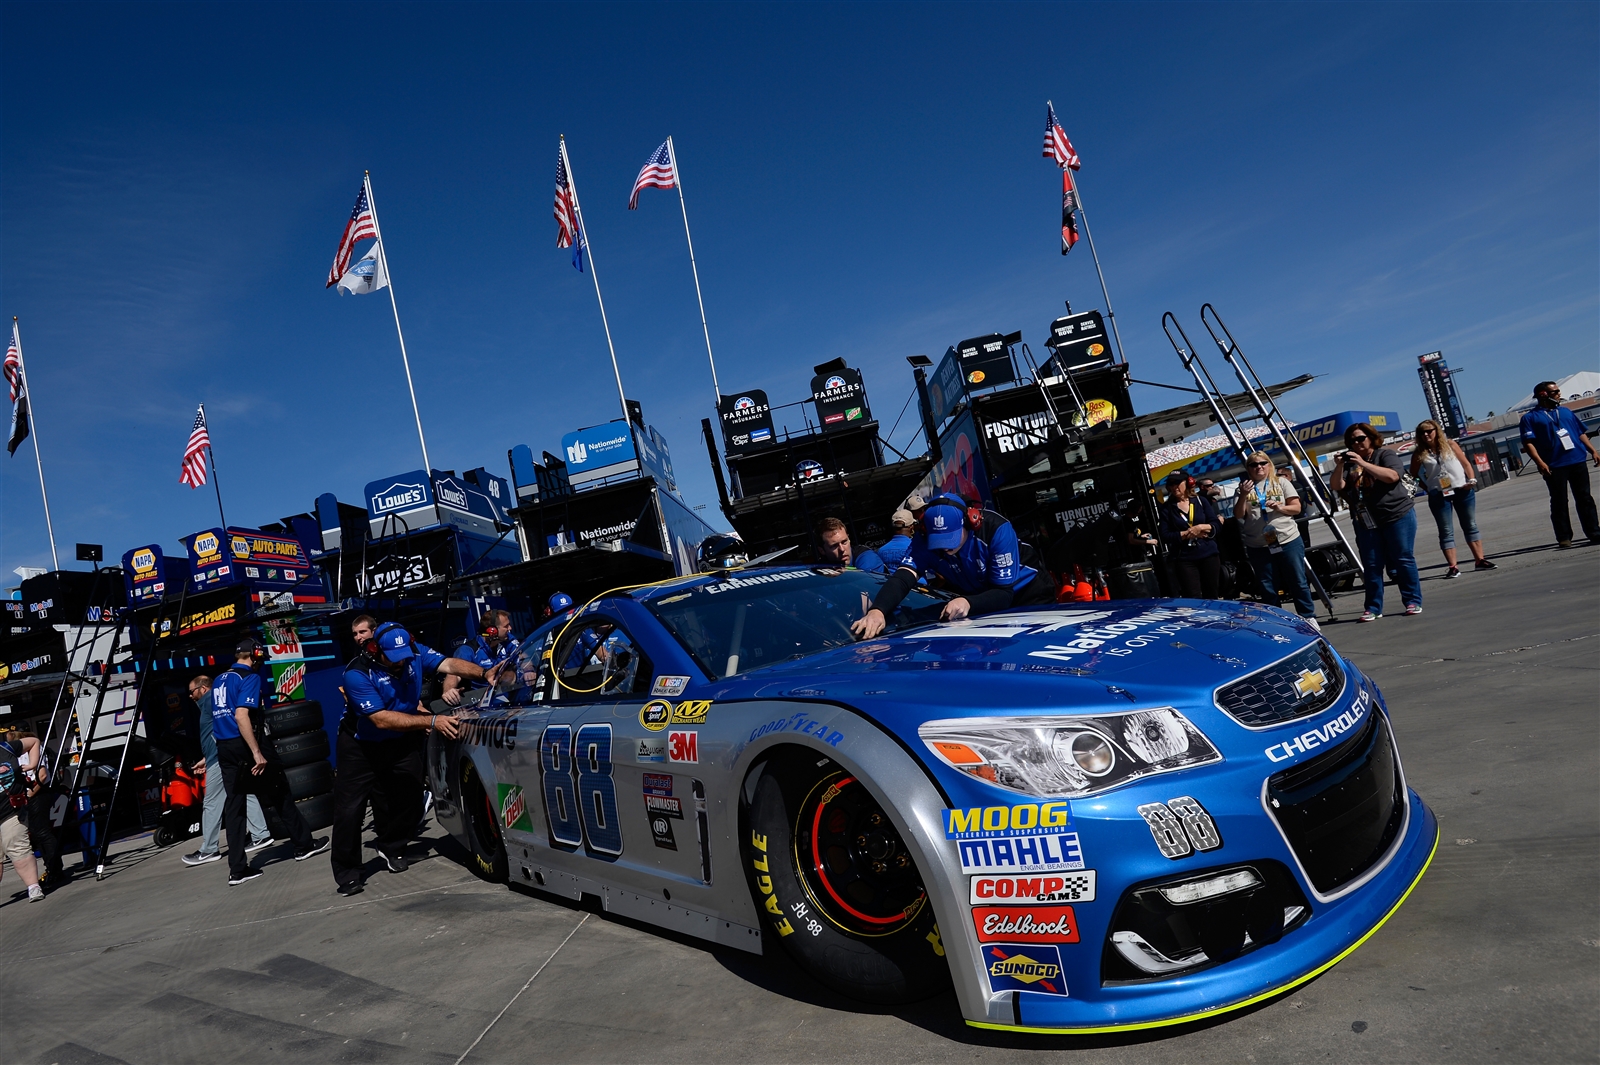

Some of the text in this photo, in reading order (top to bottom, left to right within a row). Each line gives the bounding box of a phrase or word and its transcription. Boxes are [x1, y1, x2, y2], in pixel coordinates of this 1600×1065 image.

[814, 383, 860, 400] FARMERS
[823, 393, 854, 403] INSURANCE
[723, 404, 769, 421] FARMERS
[1089, 401, 1105, 413] Bass
[1090, 410, 1104, 420] Pro
[732, 413, 762, 424] INSURANCE
[588, 436, 627, 450] Nationwide
[998, 427, 1049, 453] ROW
[1263, 420, 1336, 452] SNOCO
[439, 485, 465, 507] LOWE'S
[488, 479, 500, 498] 48
[378, 490, 421, 510] LOWE'S
[1055, 502, 1110, 523] FURNITURE
[580, 521, 637, 541] Nationwide
[606, 533, 618, 541] your
[197, 537, 216, 552] NAPA
[234, 541, 248, 554] NAPA
[253, 540, 274, 554] AUTO
[274, 542, 298, 556] PARTS
[135, 554, 153, 567] NAPA
[705, 570, 816, 595] EARNHARDT
[6, 603, 24, 611] Mob
[30, 599, 53, 612] Mobil
[206, 604, 236, 623] PARTS
[1125, 634, 1160, 647] on
[12, 657, 40, 674] Mobil
[647, 712, 661, 721] Sprint
[693, 715, 706, 724] WEAR
[1264, 699, 1366, 763] CHEVROLET
[669, 733, 697, 761] 3M
[645, 776, 671, 788] Duralast
[538, 722, 624, 862] 88
[647, 796, 680, 812] FLOWMASTER
[948, 802, 1067, 833] MOOG
[188, 822, 200, 833] 48
[1010, 826, 1065, 836] SUSPENSION
[1137, 796, 1220, 858] 88
[959, 834, 1081, 867] MAHLE
[1047, 862, 1083, 870] BEARINGS
[752, 829, 794, 938] EAGLE
[975, 877, 1064, 899] COMP
[1036, 891, 1081, 902] CAMS
[982, 912, 1071, 936] Edelbrock
[993, 963, 1058, 978] SUNOCO
